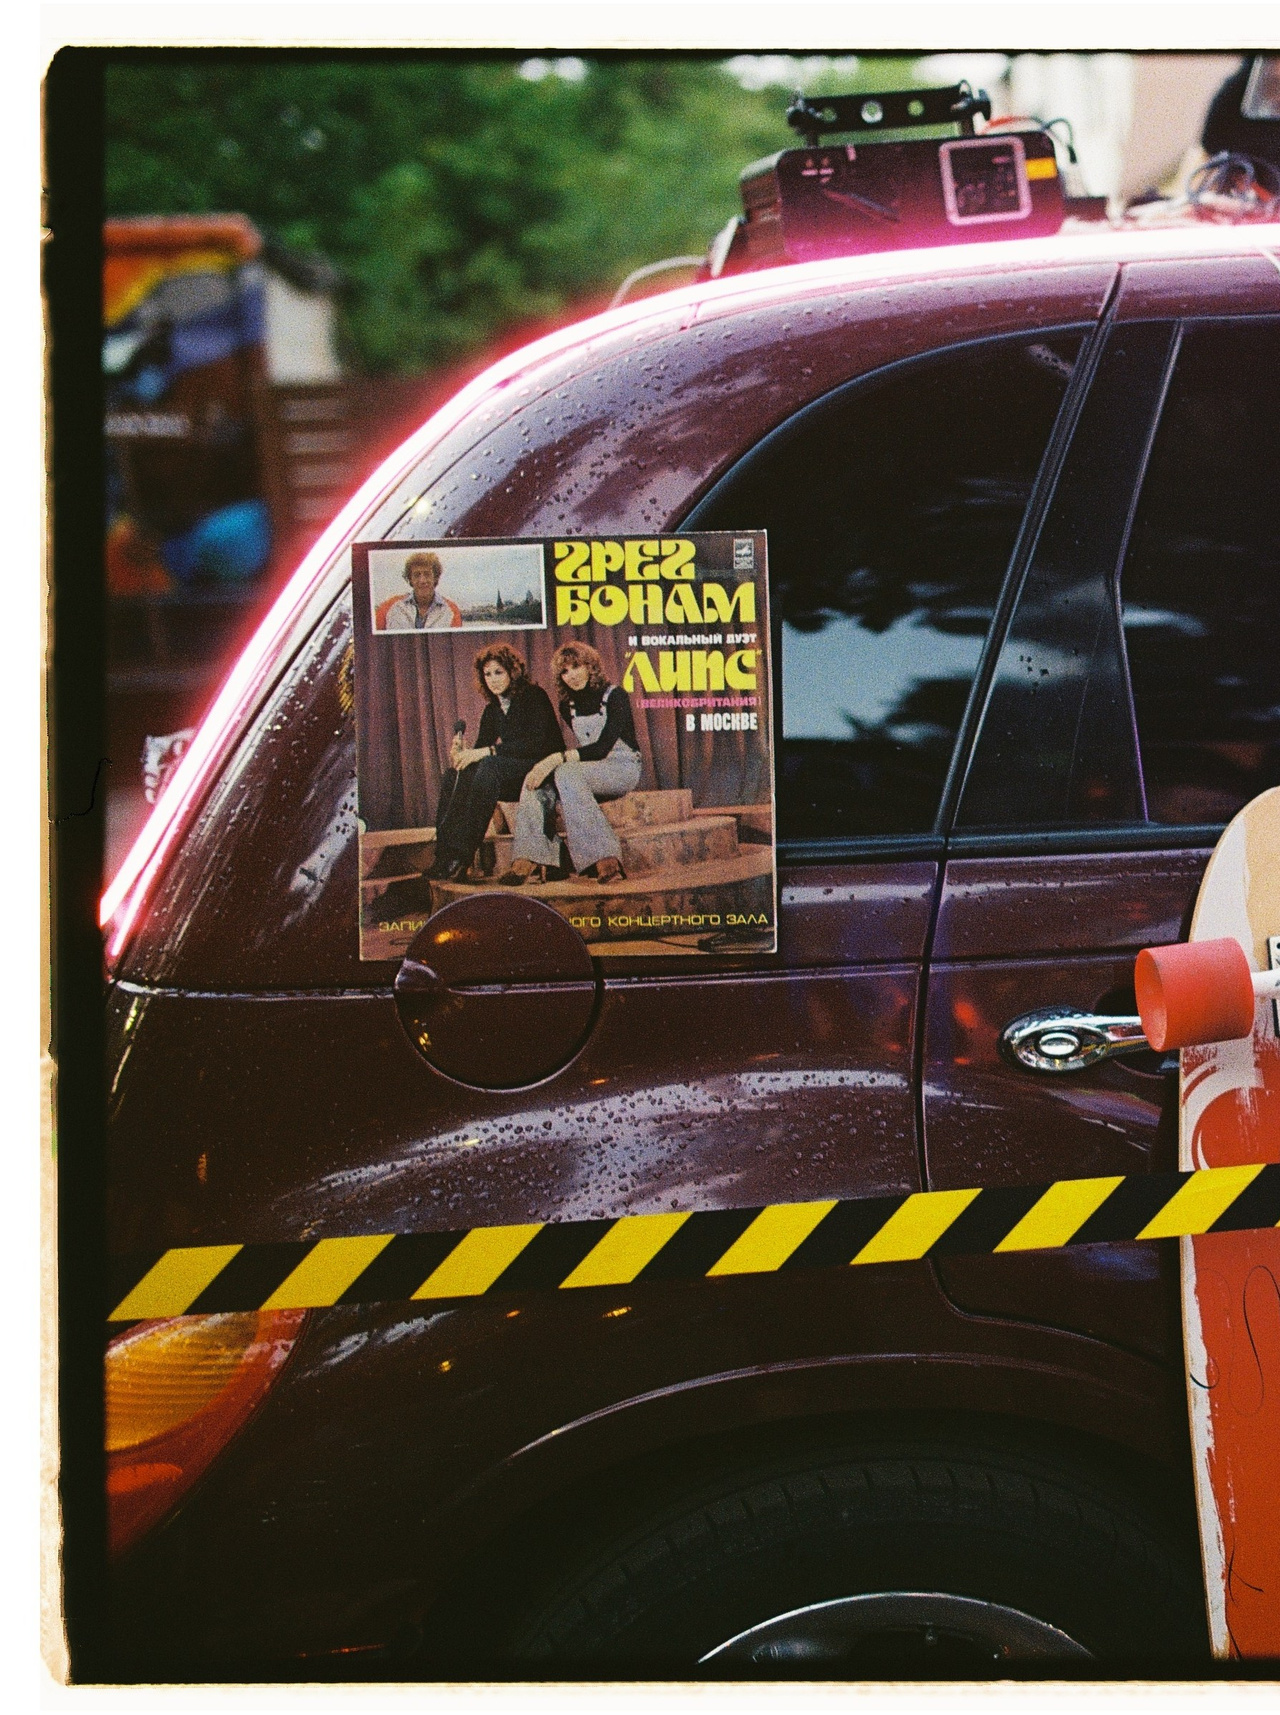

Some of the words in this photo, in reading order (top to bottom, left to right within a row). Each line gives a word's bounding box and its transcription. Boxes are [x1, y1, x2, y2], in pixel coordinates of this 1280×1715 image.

[555, 582, 756, 626] БОНАМ
[628, 635, 638, 647] И
[641, 633, 723, 646] ВОКАЛЬНЫЙ
[726, 633, 757, 645] ДУЭТ
[686, 713, 696, 732] В
[700, 712, 758, 731] МОСКВЕ
[608, 914, 721, 927] КОНЦЕРТНОГО
[726, 913, 768, 925] ЗАЛА
